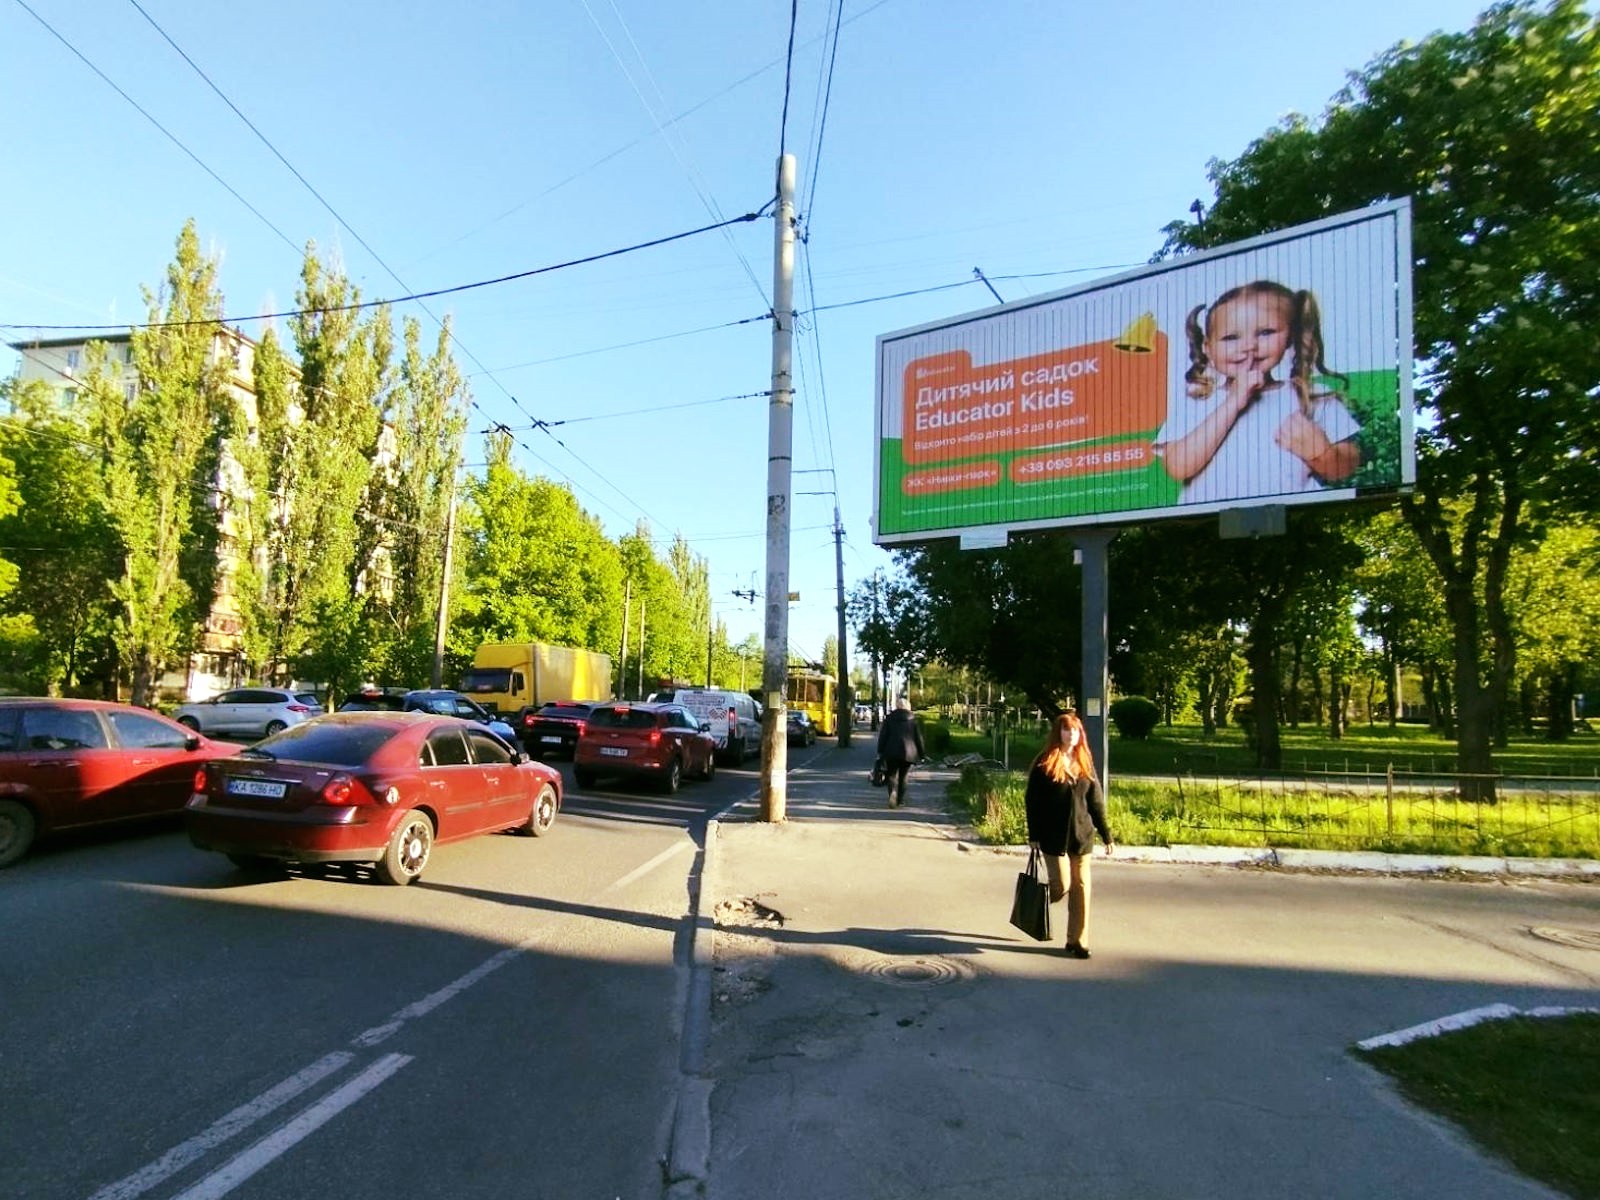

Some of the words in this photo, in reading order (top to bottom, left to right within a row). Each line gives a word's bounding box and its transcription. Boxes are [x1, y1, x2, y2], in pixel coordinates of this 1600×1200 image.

[915, 369, 1014, 410] Дитячий
[1021, 357, 1099, 385] садок
[915, 399, 1014, 431] Educator
[1021, 388, 1074, 413] Kids
[1022, 423, 1029, 433] 2
[1030, 422, 1045, 434] до
[1046, 419, 1054, 430] 6
[1018, 462, 1044, 474] +38
[1075, 454, 1100, 468] 215
